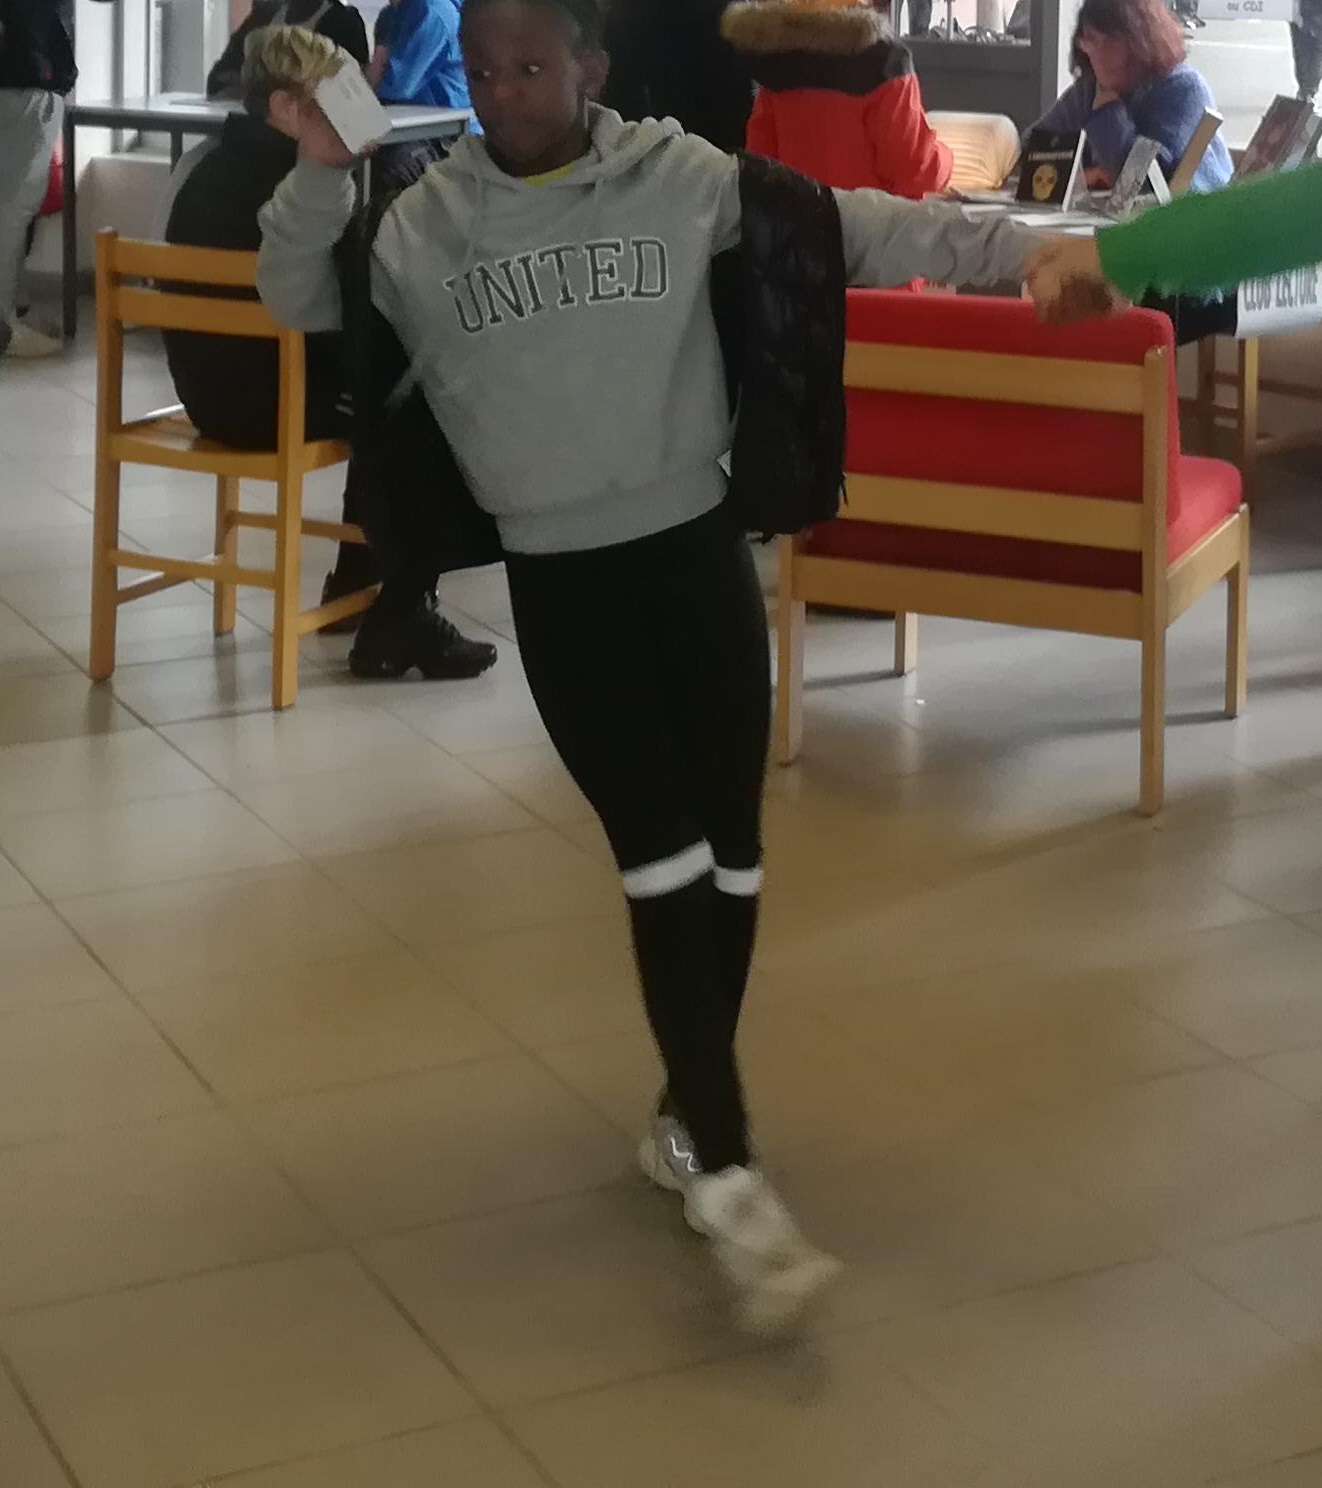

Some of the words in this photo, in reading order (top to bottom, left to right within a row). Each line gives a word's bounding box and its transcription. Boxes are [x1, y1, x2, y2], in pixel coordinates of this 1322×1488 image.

[1226, 1, 1240, 12] au
[1242, 0, 1265, 12] CDI
[443, 236, 669, 334] UNITED
